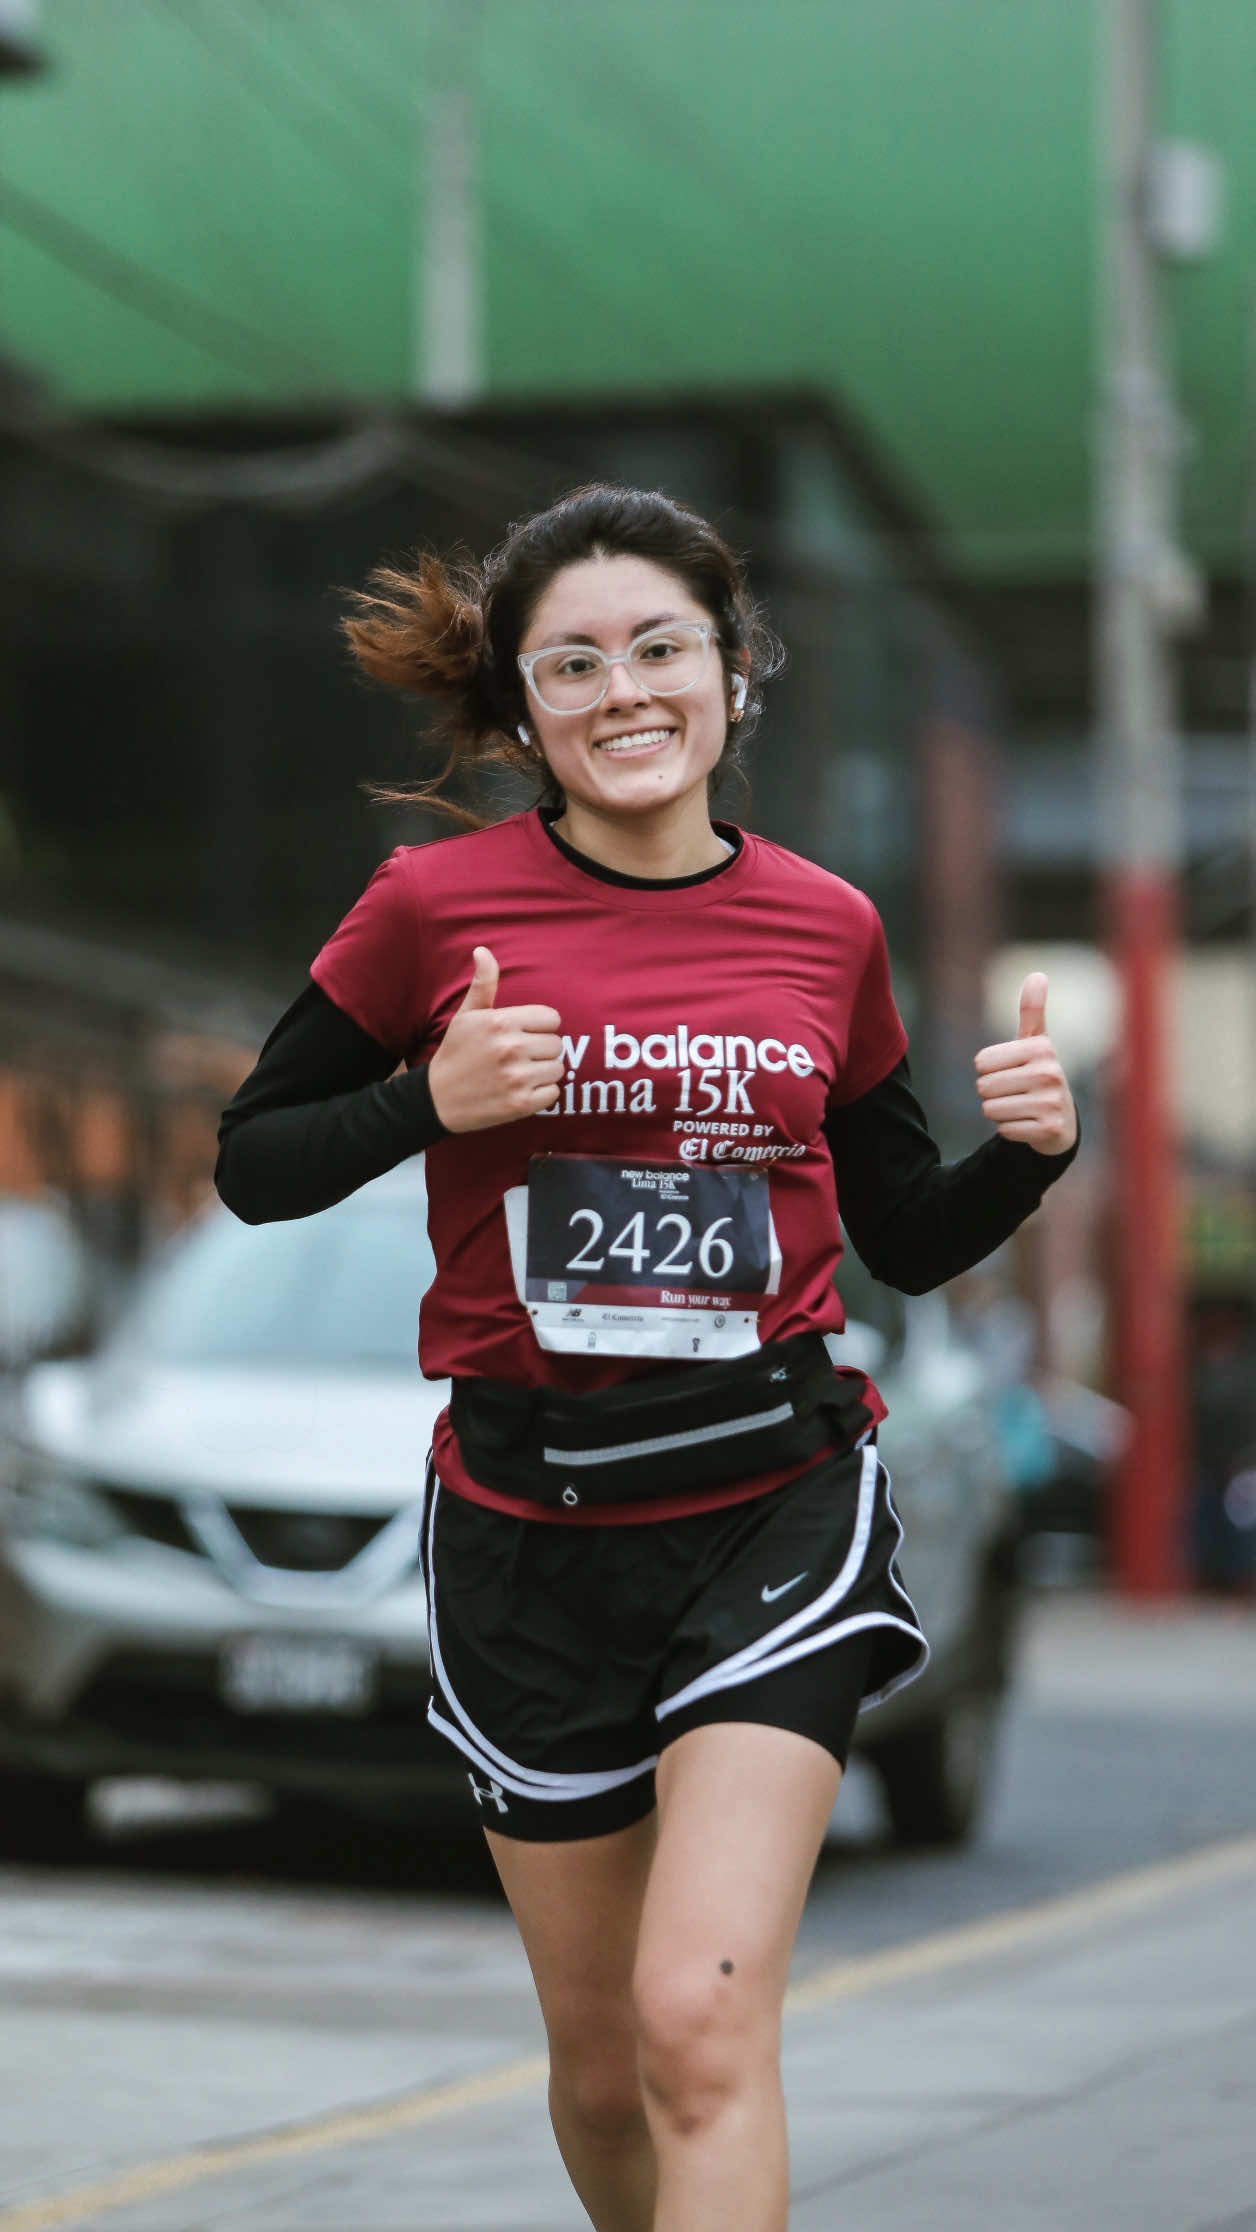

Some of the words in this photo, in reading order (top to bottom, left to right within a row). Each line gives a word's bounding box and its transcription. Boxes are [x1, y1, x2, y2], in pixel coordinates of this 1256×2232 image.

[604, 1024, 816, 1077] balance
[673, 1068, 756, 1116] 15K
[673, 1120, 750, 1136] POWERED
[753, 1125, 774, 1137] BY
[679, 1138, 709, 1160] El
[621, 1170, 643, 1180] new
[645, 1170, 690, 1182] balance
[632, 1178, 656, 1189] Lima
[565, 1208, 735, 1280] 2426
[661, 1290, 686, 1304] Run
[687, 1294, 710, 1308] your
